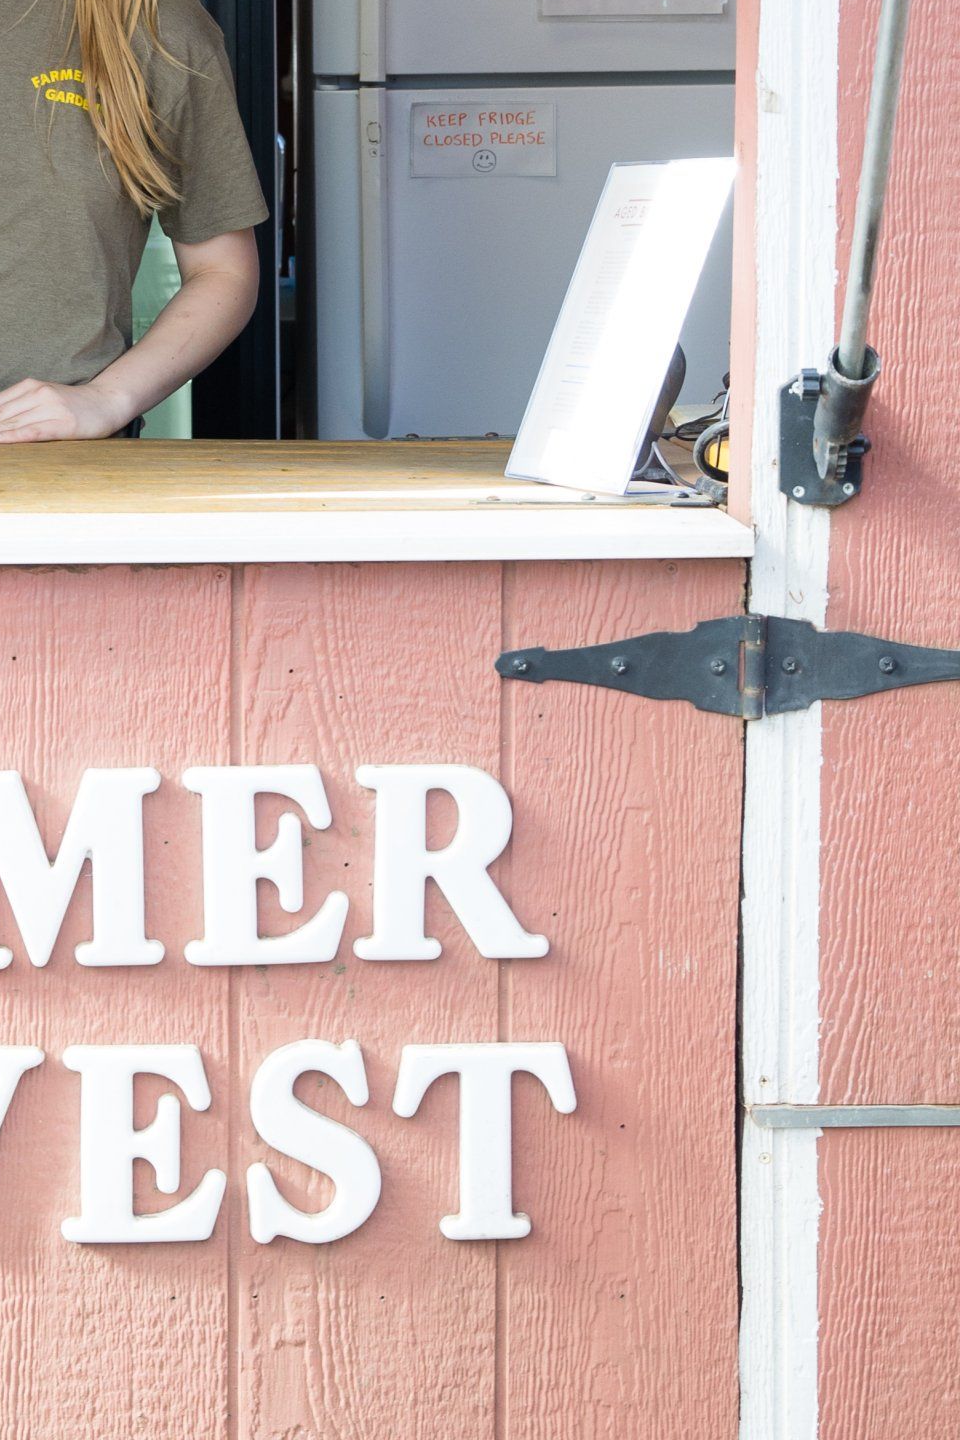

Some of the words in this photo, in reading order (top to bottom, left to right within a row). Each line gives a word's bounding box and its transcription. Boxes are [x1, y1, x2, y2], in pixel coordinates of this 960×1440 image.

[31, 68, 86, 89] FARME
[426, 112, 468, 129] KEEP
[478, 110, 536, 128] FRIDGE
[423, 132, 483, 148] CLOSED
[490, 130, 546, 146] PLEASE
